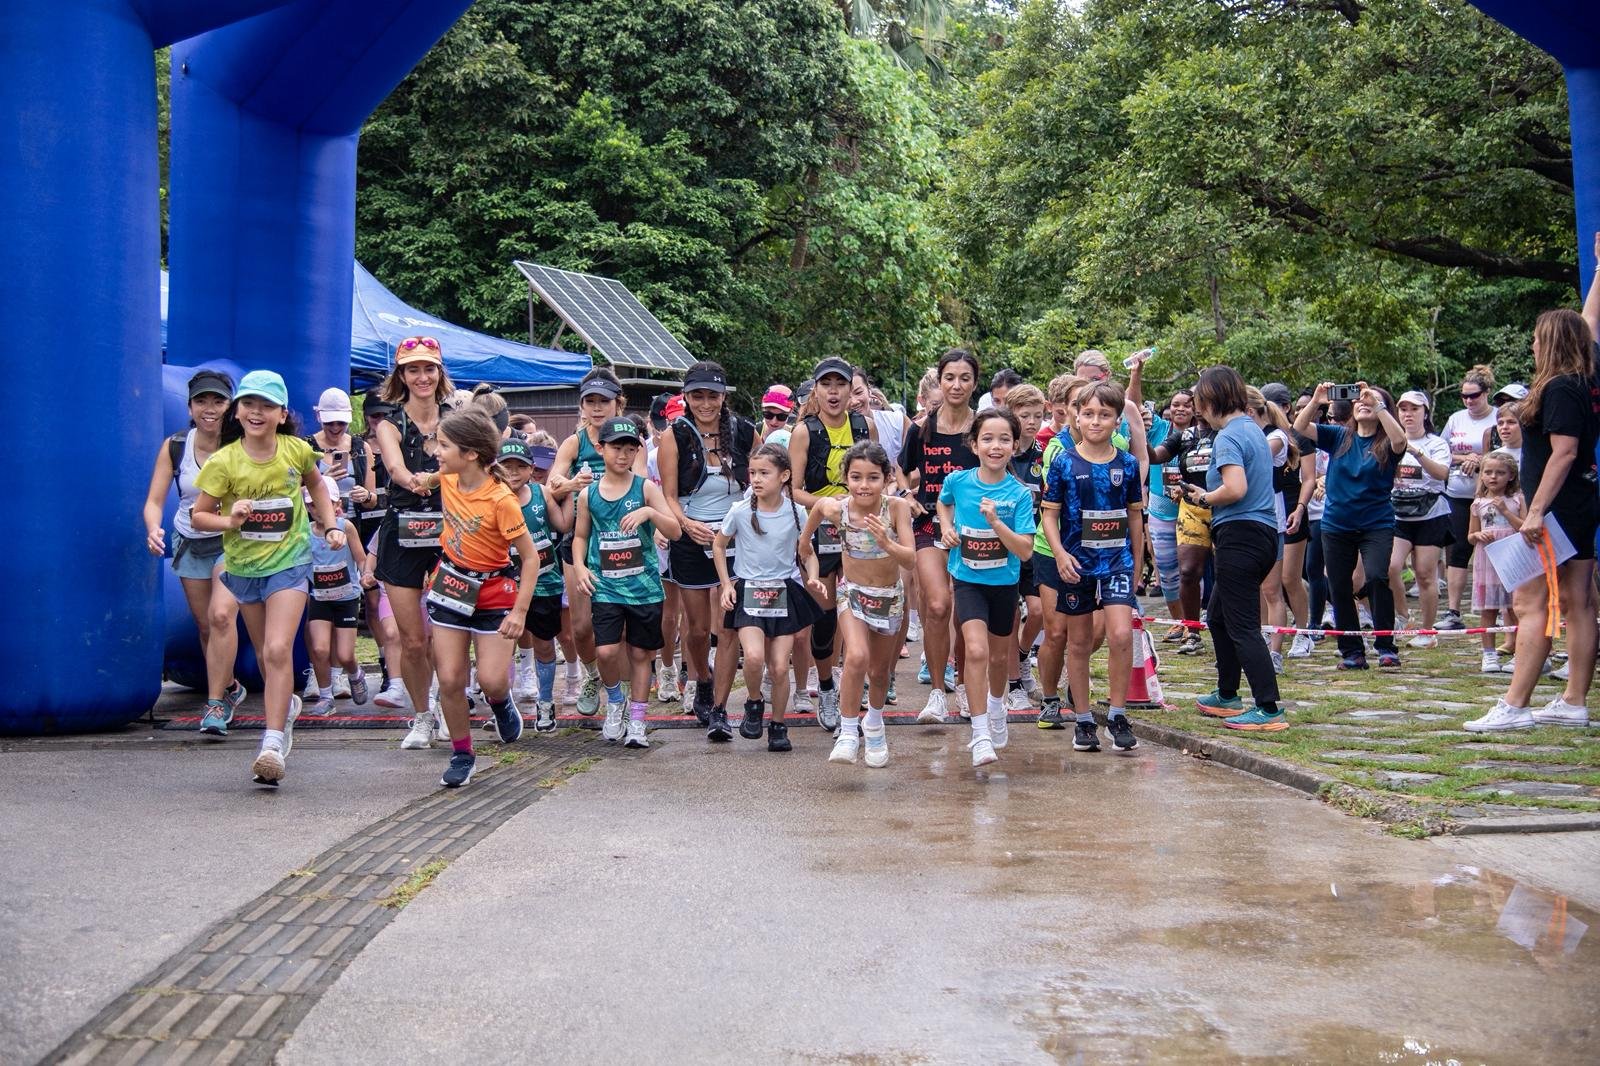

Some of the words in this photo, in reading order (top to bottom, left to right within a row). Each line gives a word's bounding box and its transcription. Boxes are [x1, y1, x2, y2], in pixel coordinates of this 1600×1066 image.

[613, 423, 636, 435] BIX
[501, 444, 525, 455] BIX
[923, 443, 952, 456] here
[1457, 442, 1473, 451] the
[925, 461, 941, 474] for
[943, 461, 964, 473] the
[248, 511, 286, 522] 50202
[407, 521, 437, 530] 50192
[1091, 521, 1120, 531] 50271
[967, 540, 1000, 551] 50232
[608, 551, 632, 561] 4040
[317, 572, 344, 582] 50032
[442, 575, 469, 593] 50191
[1109, 573, 1130, 593] 43
